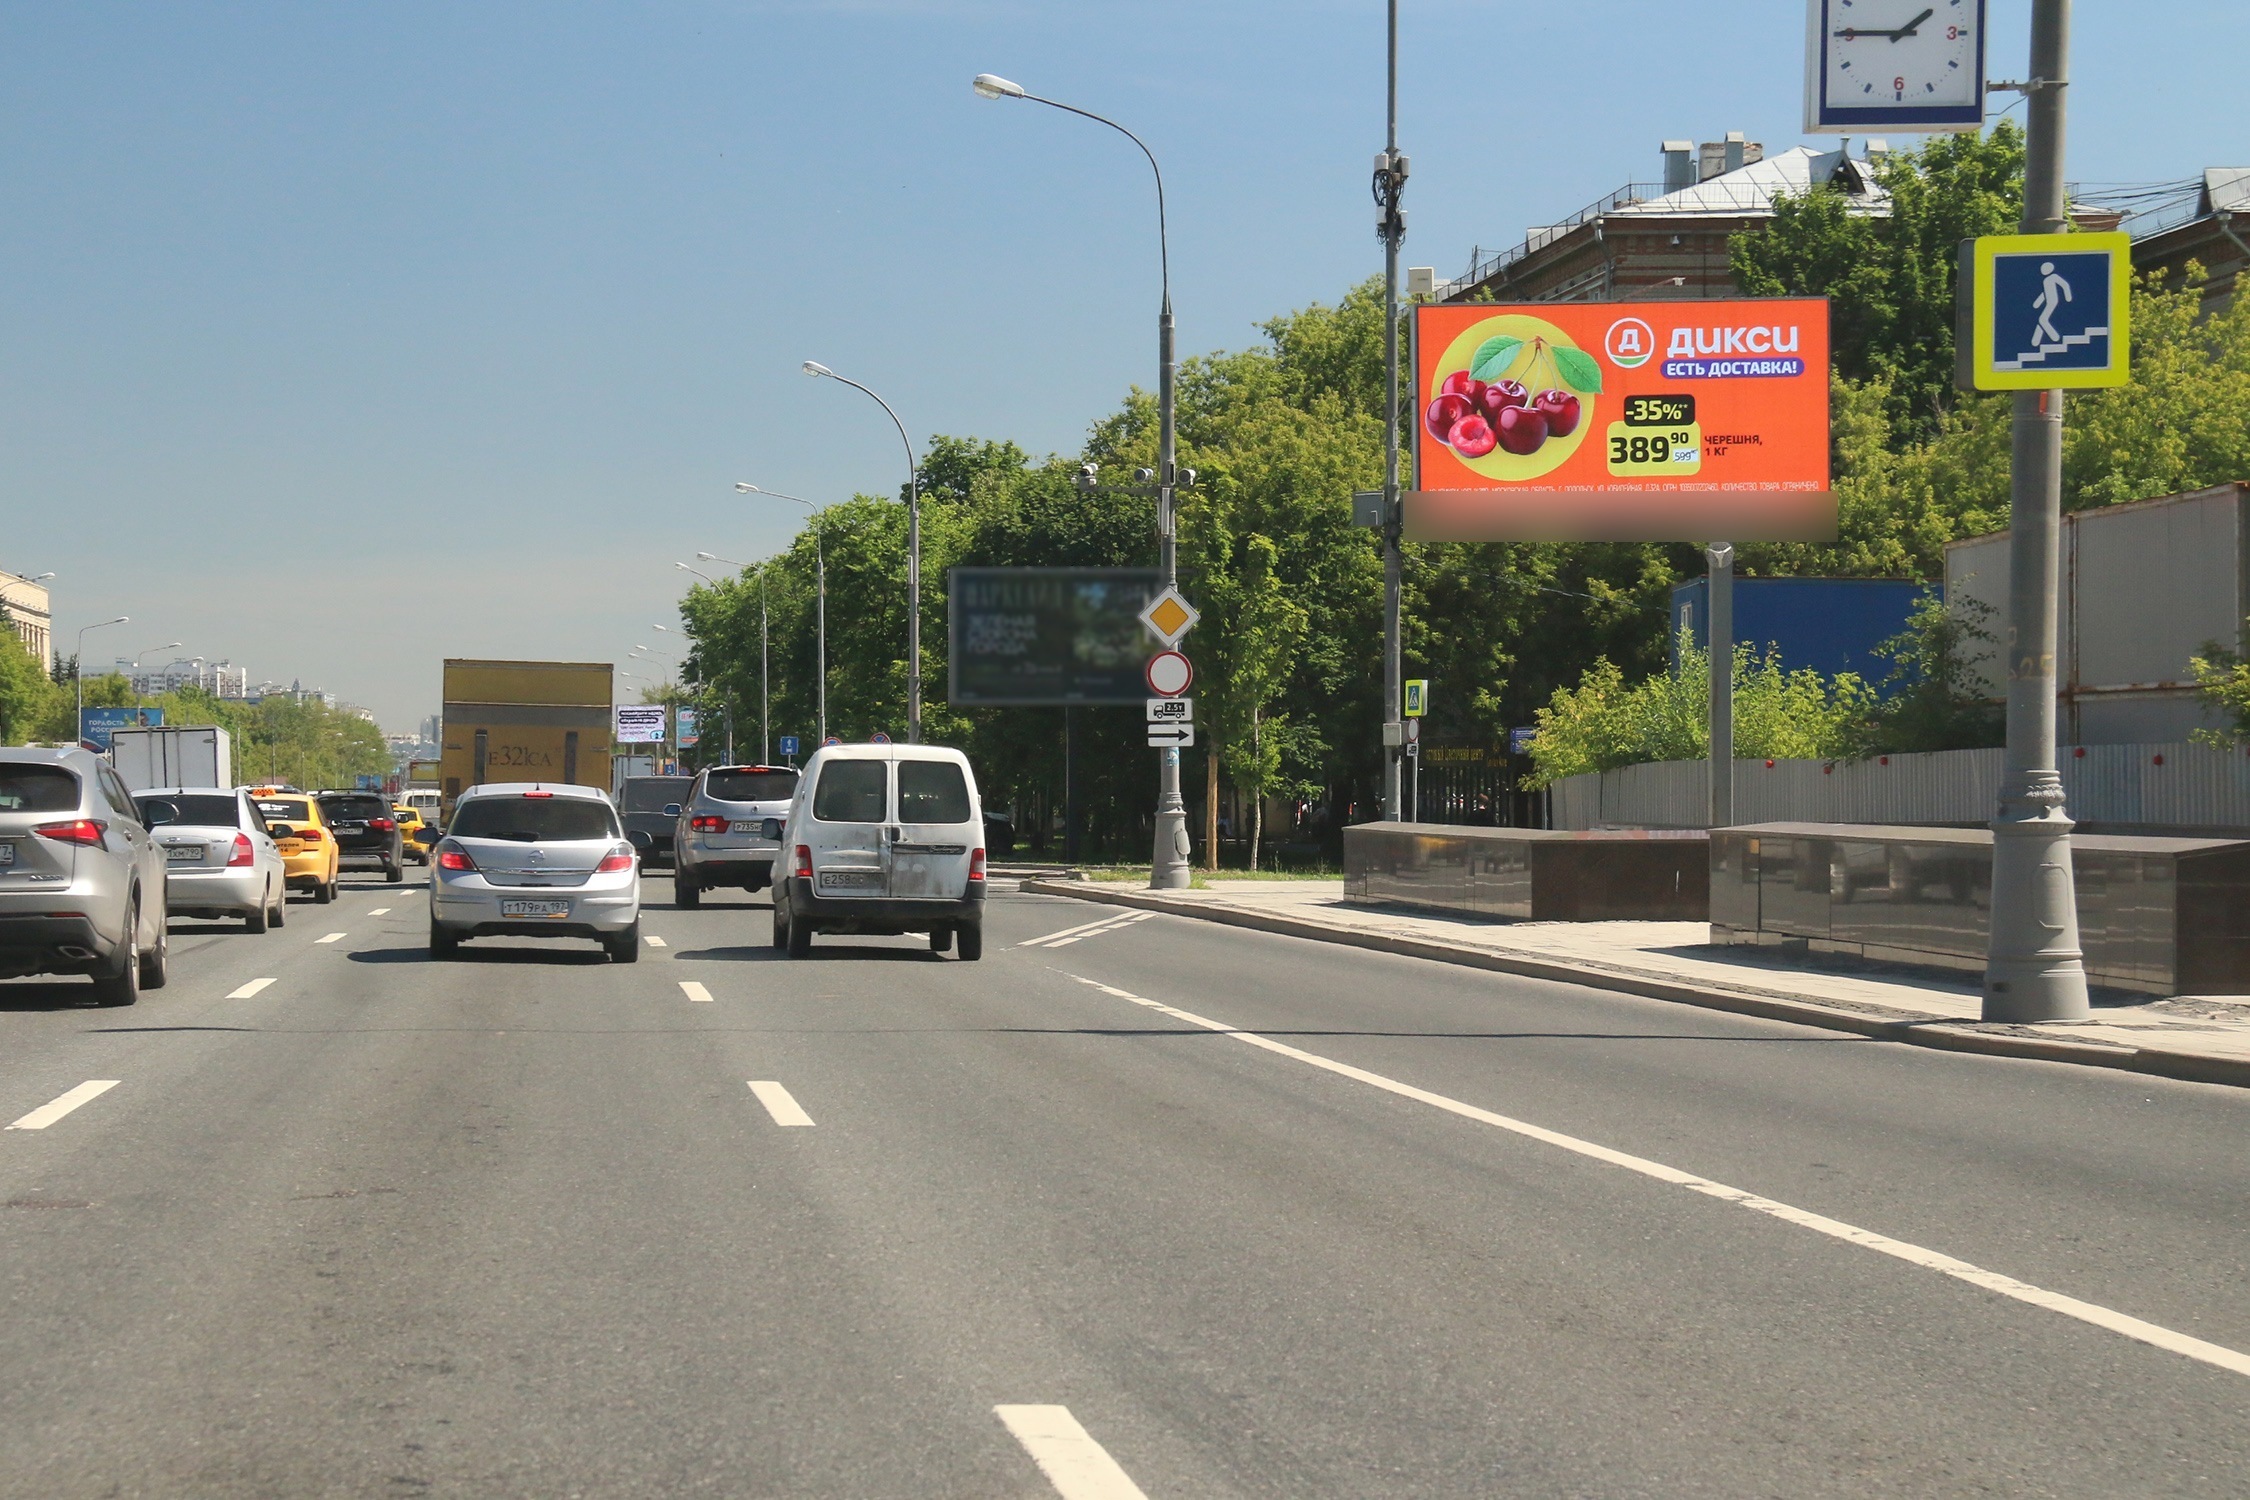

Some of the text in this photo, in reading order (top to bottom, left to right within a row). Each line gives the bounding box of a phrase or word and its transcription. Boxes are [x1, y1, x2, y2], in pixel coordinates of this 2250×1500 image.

[1947, 27, 1957, 40] 3
[1894, 77, 1904, 90] 6
[1667, 361, 1797, 378] ЕСТЬ ДОСТАВКА!
[1705, 435, 1763, 446] ЧЕРЕШНЯ,
[1610, 432, 1689, 463] 389 90
[1706, 448, 1711, 456] 1
[1714, 447, 1728, 456] КГ
